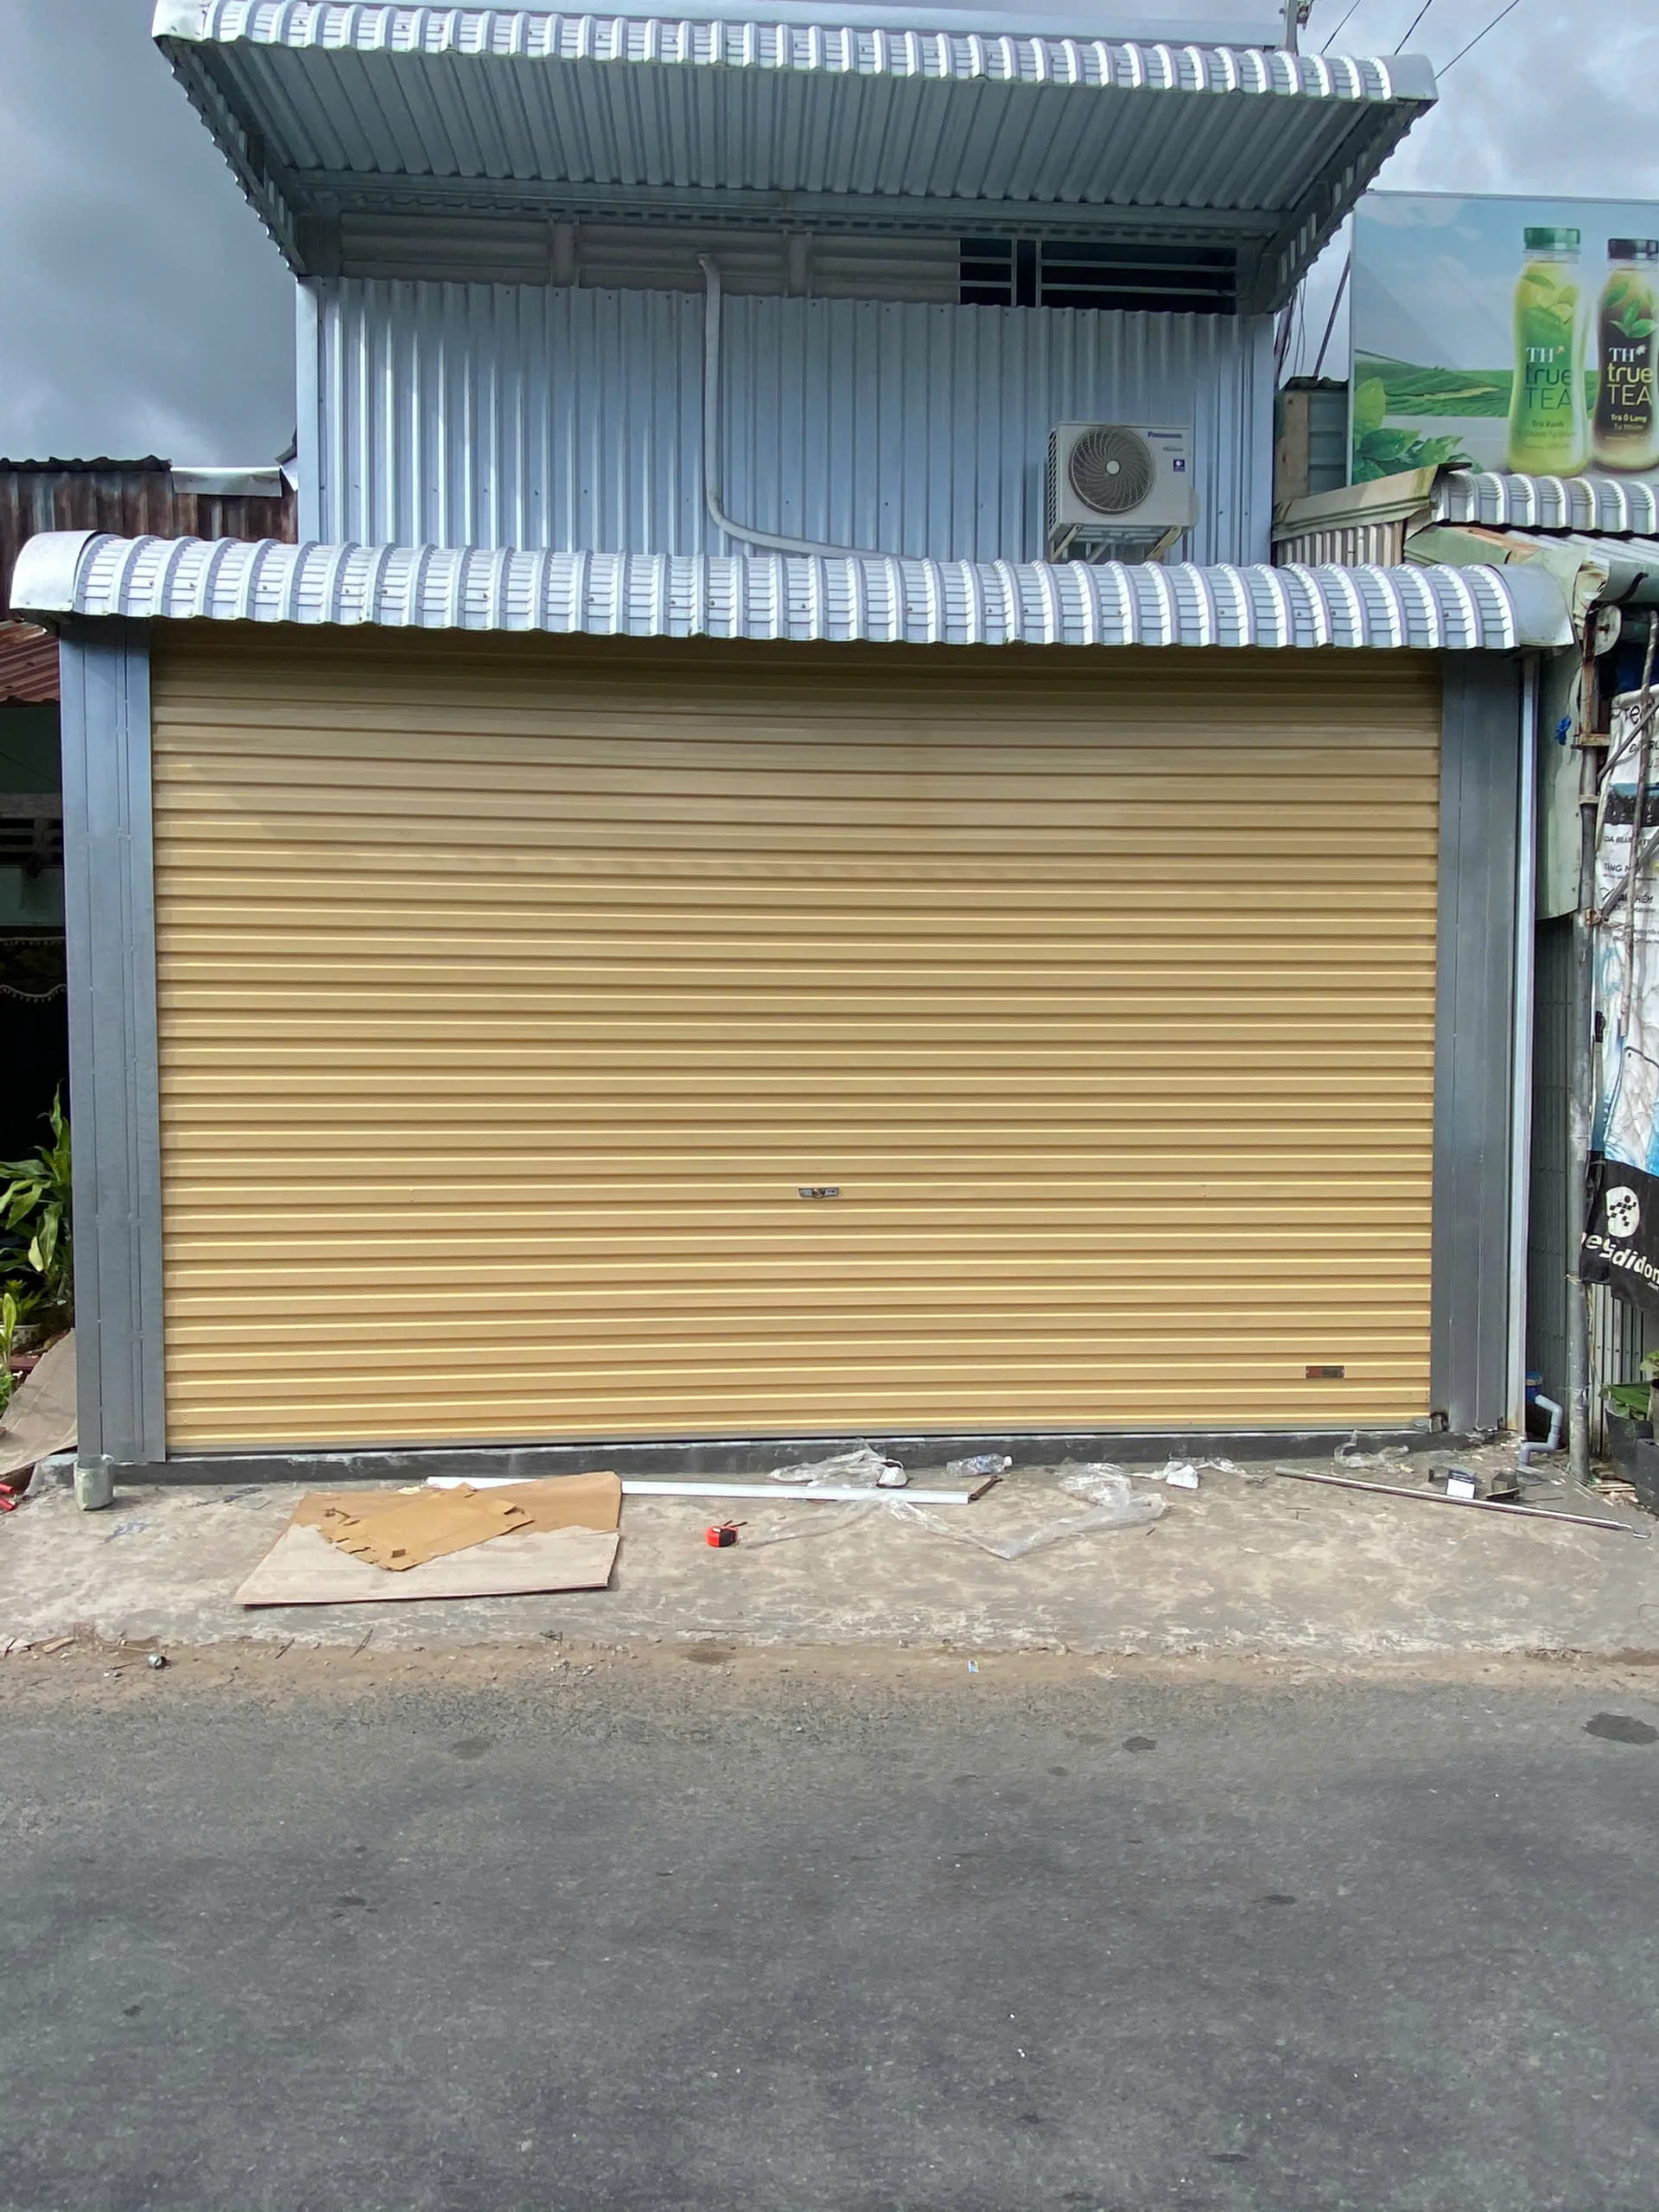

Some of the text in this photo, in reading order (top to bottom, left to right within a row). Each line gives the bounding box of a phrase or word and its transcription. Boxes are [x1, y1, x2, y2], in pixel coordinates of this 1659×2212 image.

[1526, 347, 1554, 363] TH
[1609, 347, 1635, 363] TH
[1526, 363, 1572, 385] true
[1607, 362, 1652, 384] true
[1525, 388, 1572, 410] TEA
[1605, 385, 1652, 406] TEA
